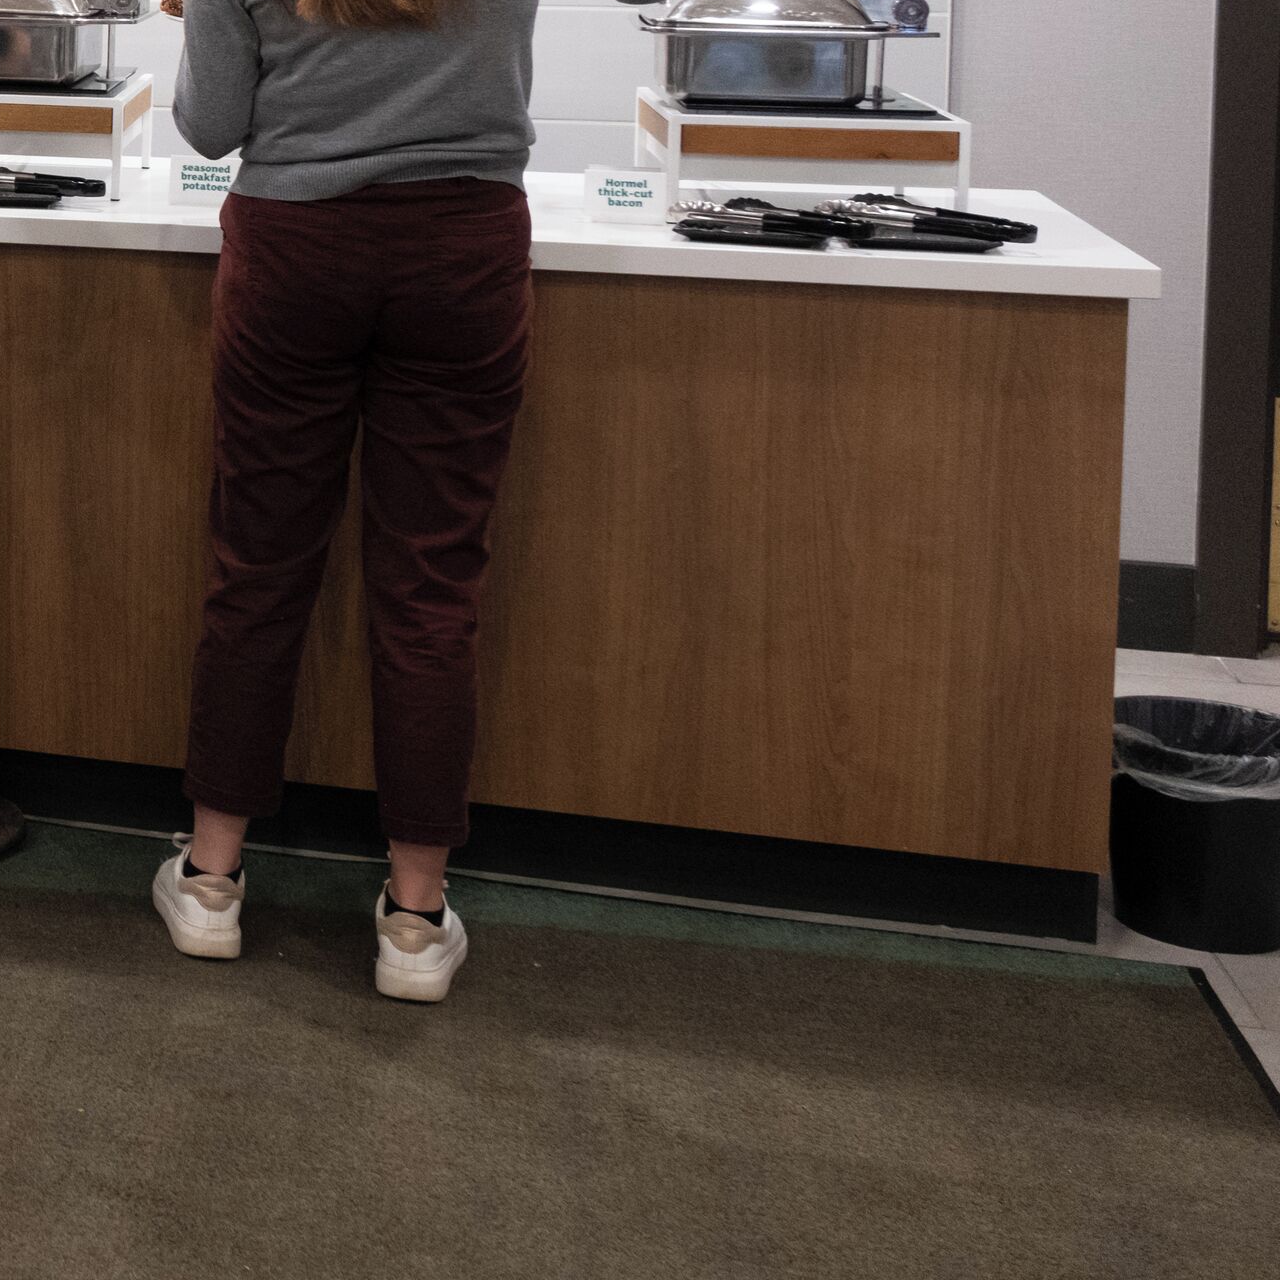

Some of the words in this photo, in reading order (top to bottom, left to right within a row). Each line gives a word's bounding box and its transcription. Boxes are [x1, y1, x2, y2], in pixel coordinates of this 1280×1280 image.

[182, 165, 231, 173] seasoned
[181, 171, 231, 183] breakfast
[182, 182, 229, 191] potatoes
[605, 178, 647, 188] Hormel
[598, 187, 653, 198] thick-cut
[608, 197, 643, 207] bacon
